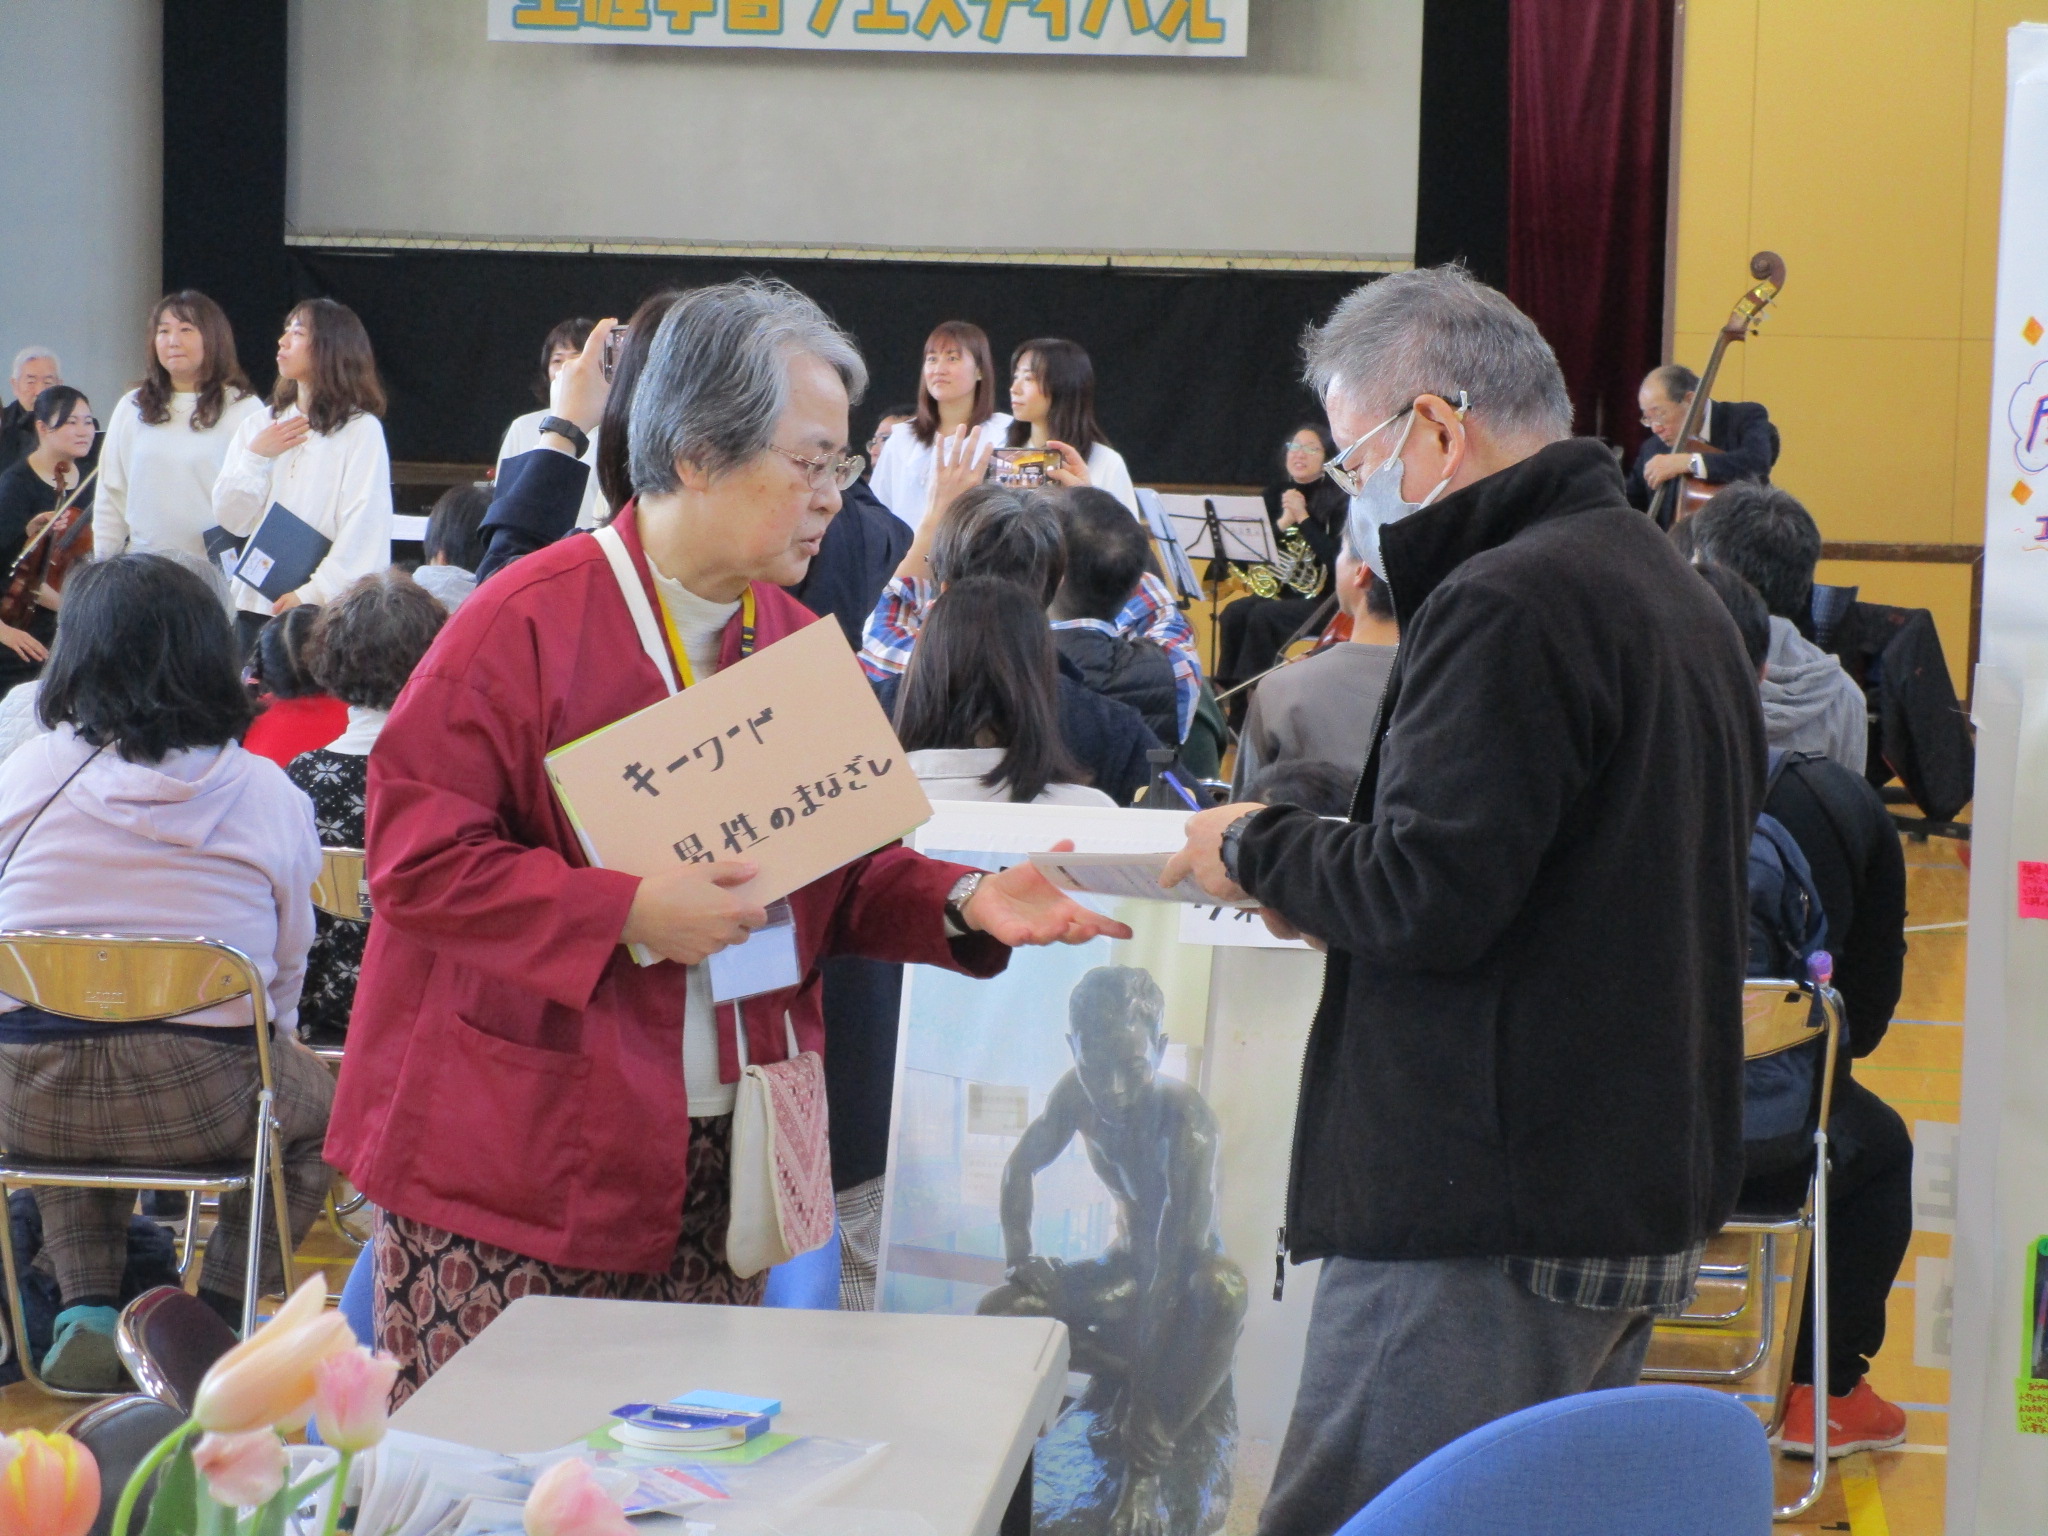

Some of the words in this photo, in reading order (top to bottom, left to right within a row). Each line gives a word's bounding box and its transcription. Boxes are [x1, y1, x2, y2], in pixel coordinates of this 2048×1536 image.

[622, 707, 774, 797] キーワード
[672, 755, 893, 865] 男性のまなざし
